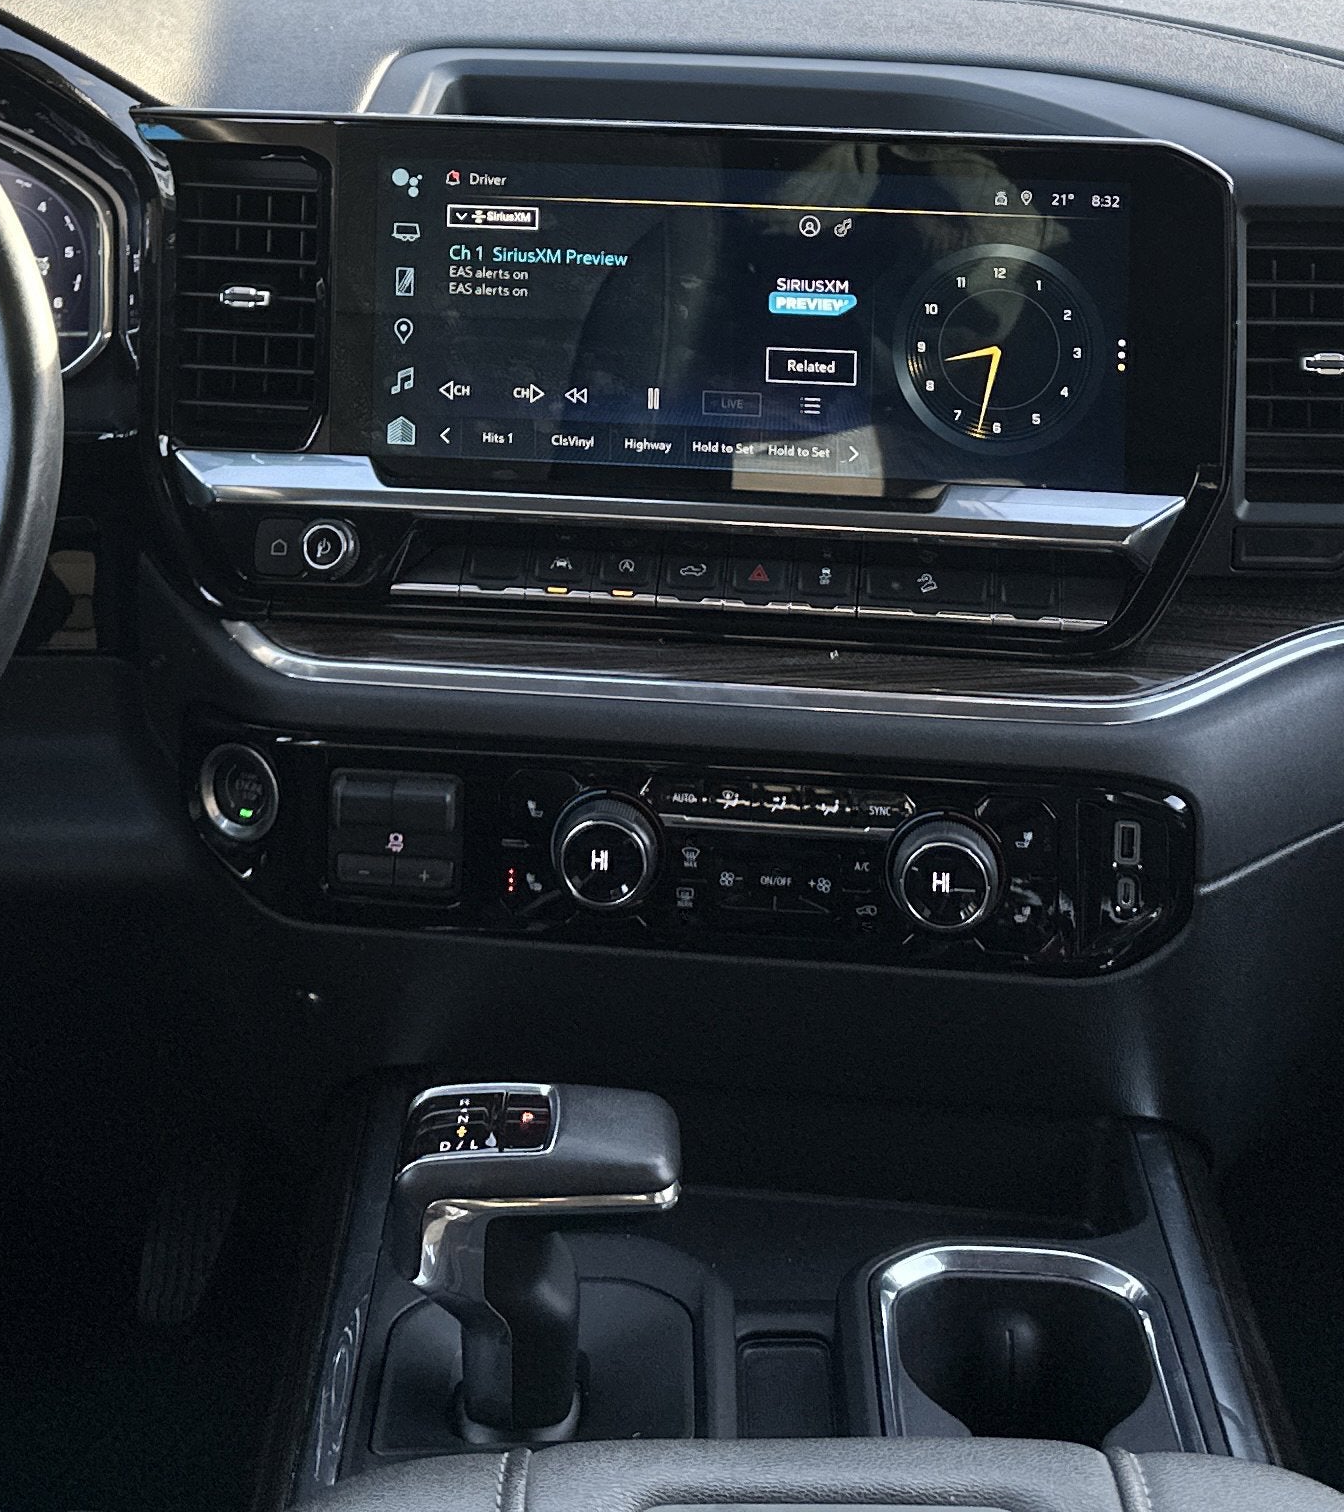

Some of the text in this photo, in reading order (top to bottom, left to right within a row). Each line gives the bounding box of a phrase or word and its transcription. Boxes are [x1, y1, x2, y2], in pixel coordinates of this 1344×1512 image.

[469, 172, 507, 186] Driver
[1051, 193, 1120, 208] 21° 8:32
[37, 201, 47, 213] 4
[486, 210, 531, 223] SiriusXM
[449, 244, 628, 267] Ch 1 SiriusXM Preview
[449, 266, 529, 281] EAS alerts on
[993, 267, 1006, 279] 12
[956, 276, 966, 288] 11
[1035, 279, 1042, 291] 1
[449, 282, 529, 297] EAS alerts on
[775, 296, 849, 312] PREVIEW
[924, 303, 938, 315] 10
[1063, 309, 1072, 321] 2
[917, 341, 926, 353] 9
[1072, 347, 1082, 359] 3
[787, 359, 836, 374] Related
[454, 385, 471, 396] CH
[925, 380, 935, 392] 8
[1060, 386, 1069, 398] 4
[513, 387, 529, 399] CH
[721, 397, 745, 409] LIVE
[953, 409, 962, 421] 7
[1031, 413, 1041, 425] 5
[992, 422, 1002, 434] 6
[482, 431, 513, 444] Hits 1
[551, 434, 595, 450] ClsVinyl
[624, 437, 672, 454] Highway
[692, 441, 754, 455] Hold to Set
[768, 444, 831, 459] Hold to Set
[672, 792, 697, 803] AUTO
[868, 804, 892, 817] SYNC
[591, 849, 609, 871] HI
[854, 861, 870, 873] A/C
[760, 874, 793, 887] ON/OFF
[931, 871, 950, 894] HI
[457, 1114, 470, 1124] N
[522, 1111, 535, 1124] P
[439, 1139, 479, 1152] D L
